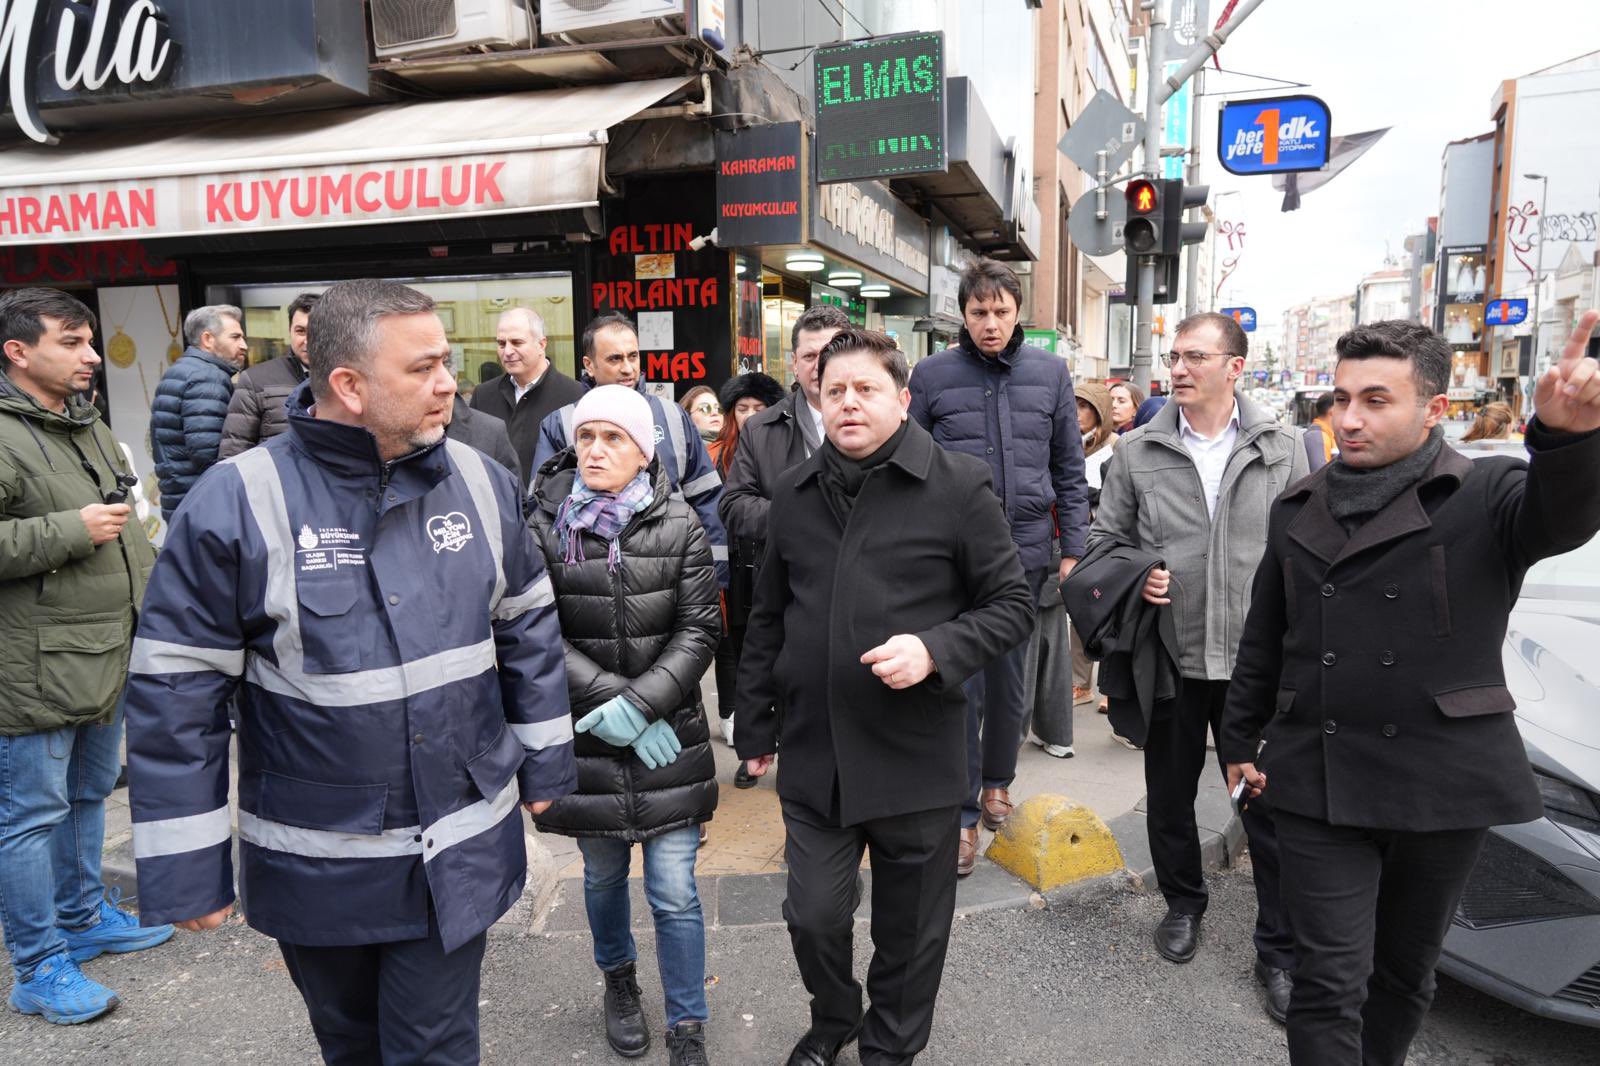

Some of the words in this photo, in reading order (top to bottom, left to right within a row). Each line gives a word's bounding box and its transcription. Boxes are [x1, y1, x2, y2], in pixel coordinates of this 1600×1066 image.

[823, 55, 934, 105] ELMAS
[1226, 141, 1263, 160] yere
[1235, 128, 1264, 145] her
[1254, 109, 1280, 165] 1
[721, 155, 796, 176] KAHRAMAN
[206, 161, 506, 223] KUYUMCULUK
[722, 201, 798, 218] KUYUMCULUK
[609, 223, 693, 256] ALTIN
[592, 277, 719, 310] PIRLANTA
